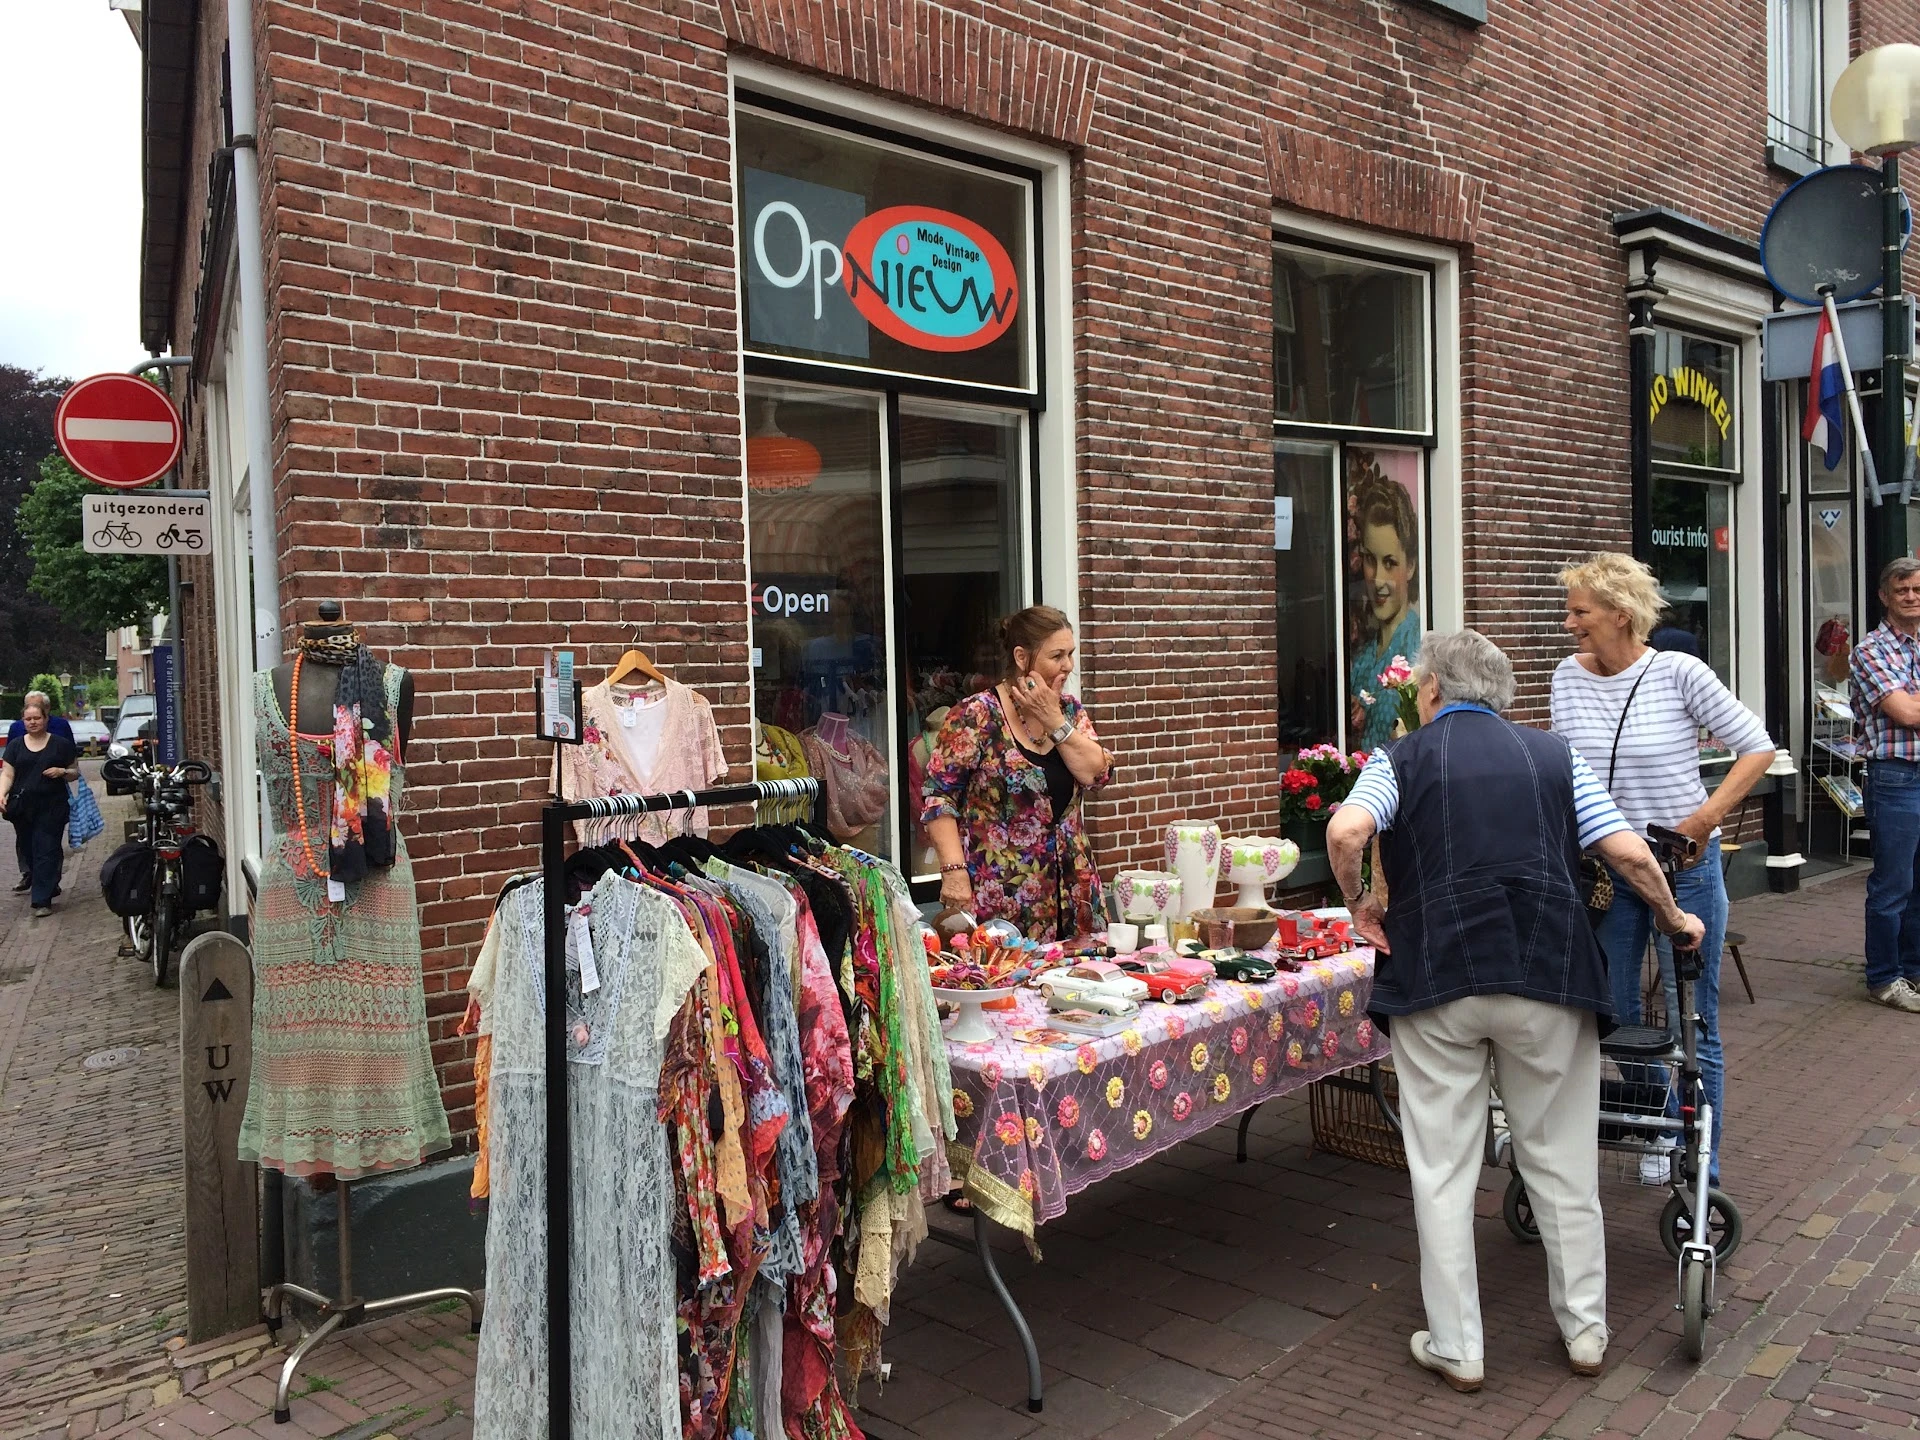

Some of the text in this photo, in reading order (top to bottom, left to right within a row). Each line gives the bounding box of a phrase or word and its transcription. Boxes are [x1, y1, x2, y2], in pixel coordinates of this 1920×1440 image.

[917, 228, 944, 245] Mode
[753, 200, 844, 320] Op
[932, 255, 962, 273] Design
[945, 243, 980, 263] Vintage
[1672, 366, 1732, 441] WINKEL
[91, 501, 205, 517] uitgezonderd
[1651, 524, 1709, 548] ourist info
[762, 585, 830, 618] Open
[166, 706, 175, 760] cadeauwinkel
[205, 1045, 231, 1070] U
[202, 1078, 236, 1104] W
